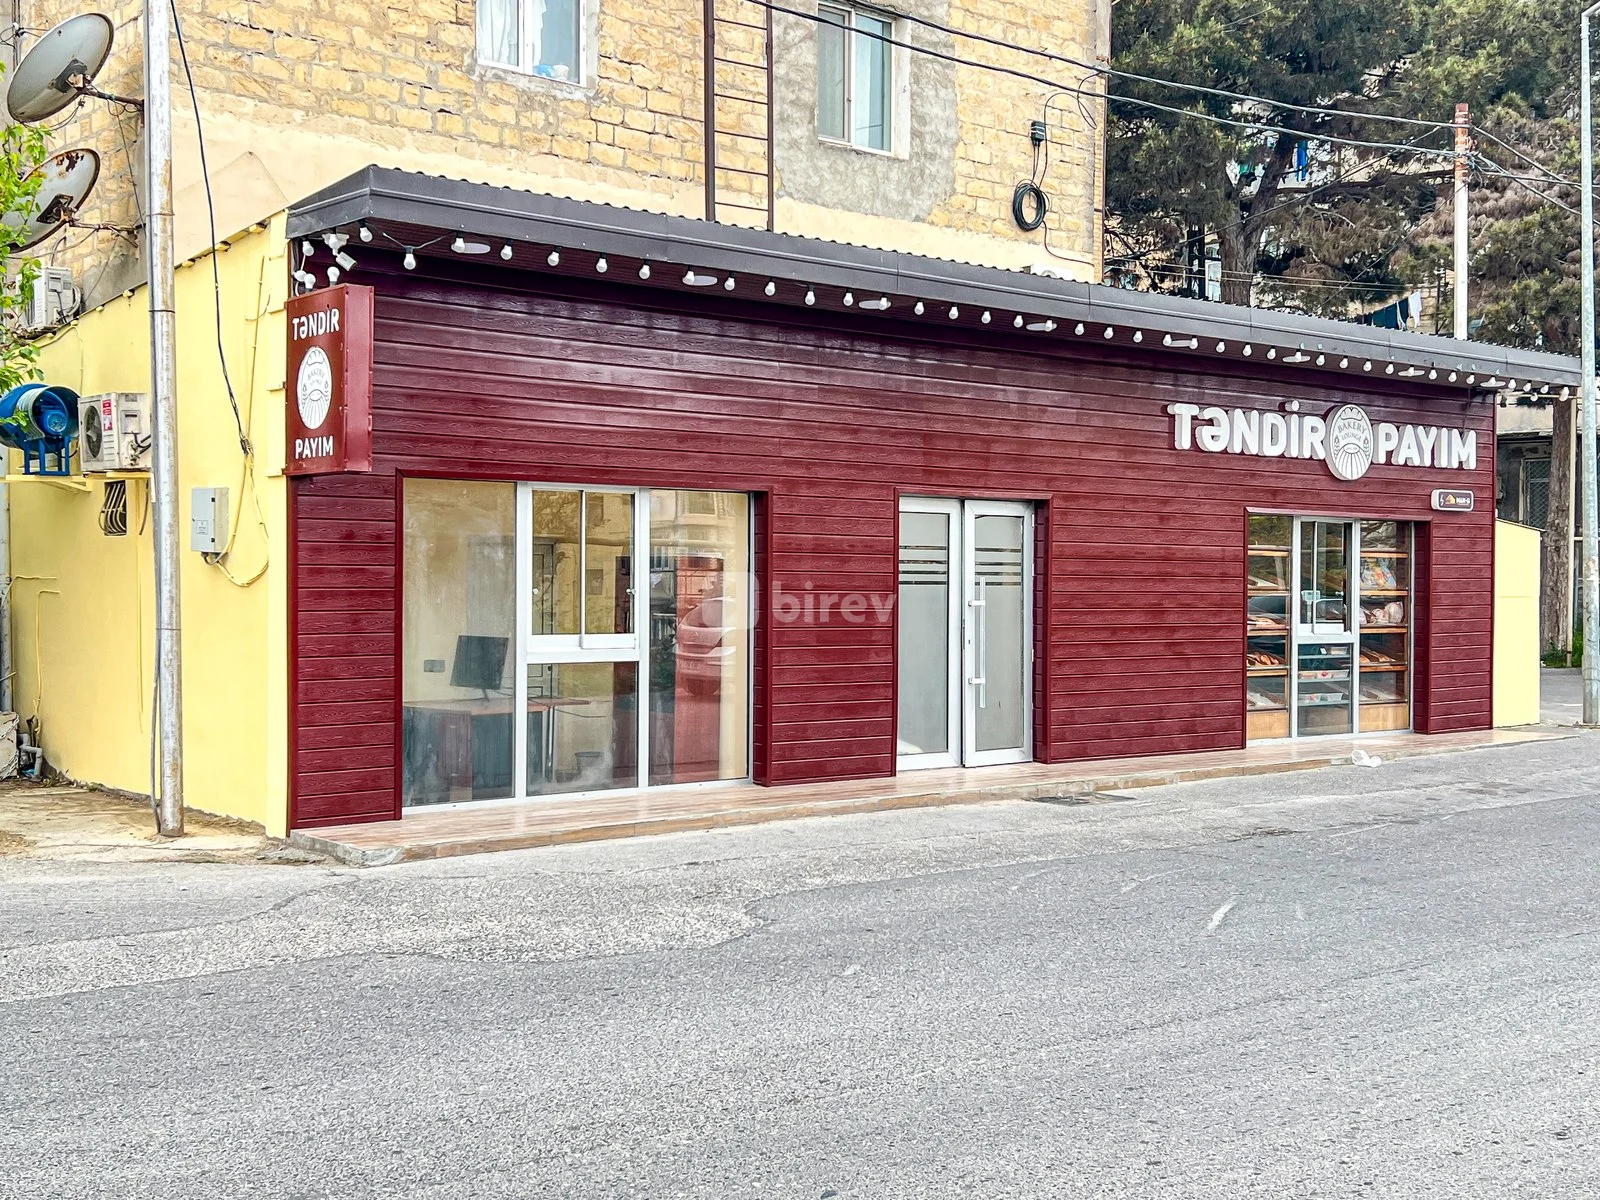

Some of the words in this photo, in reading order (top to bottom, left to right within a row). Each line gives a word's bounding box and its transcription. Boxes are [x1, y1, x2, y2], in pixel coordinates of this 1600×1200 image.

[1169, 400, 1326, 460] TƏNDİR
[1376, 422, 1477, 470] PAYIM
[1338, 421, 1367, 434] BAKERY
[295, 435, 334, 460] PAYIM
